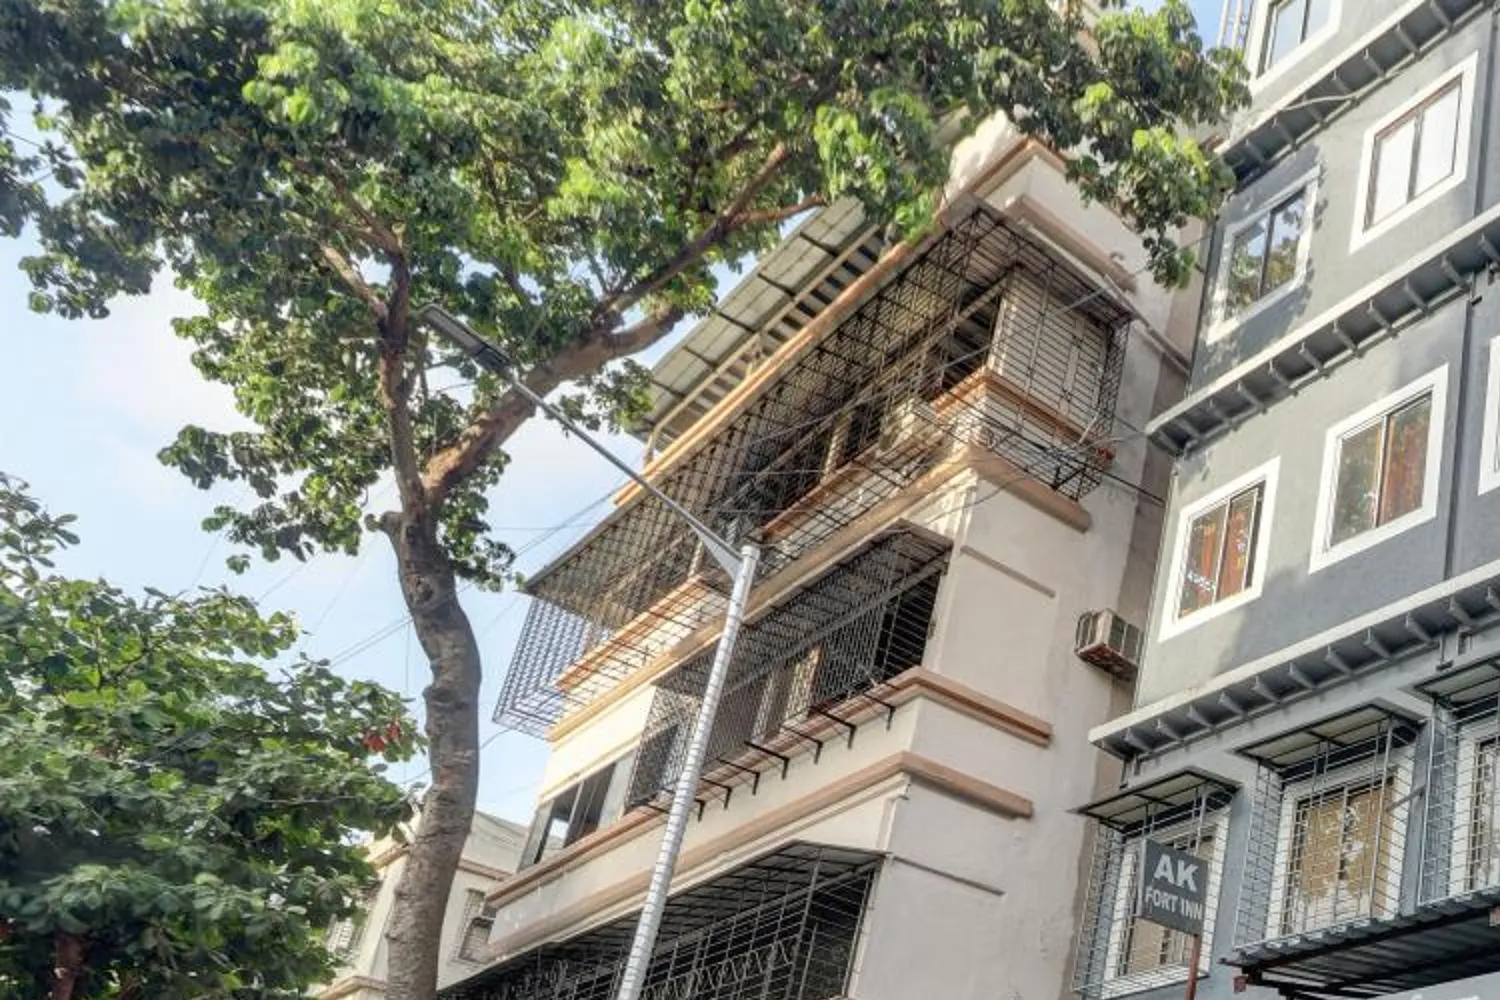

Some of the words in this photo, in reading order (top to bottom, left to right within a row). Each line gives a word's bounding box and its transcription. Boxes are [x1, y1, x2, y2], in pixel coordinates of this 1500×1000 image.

[1153, 854, 1199, 893] AK
[1145, 886, 1178, 913] FORT
[1180, 897, 1204, 920] INN
